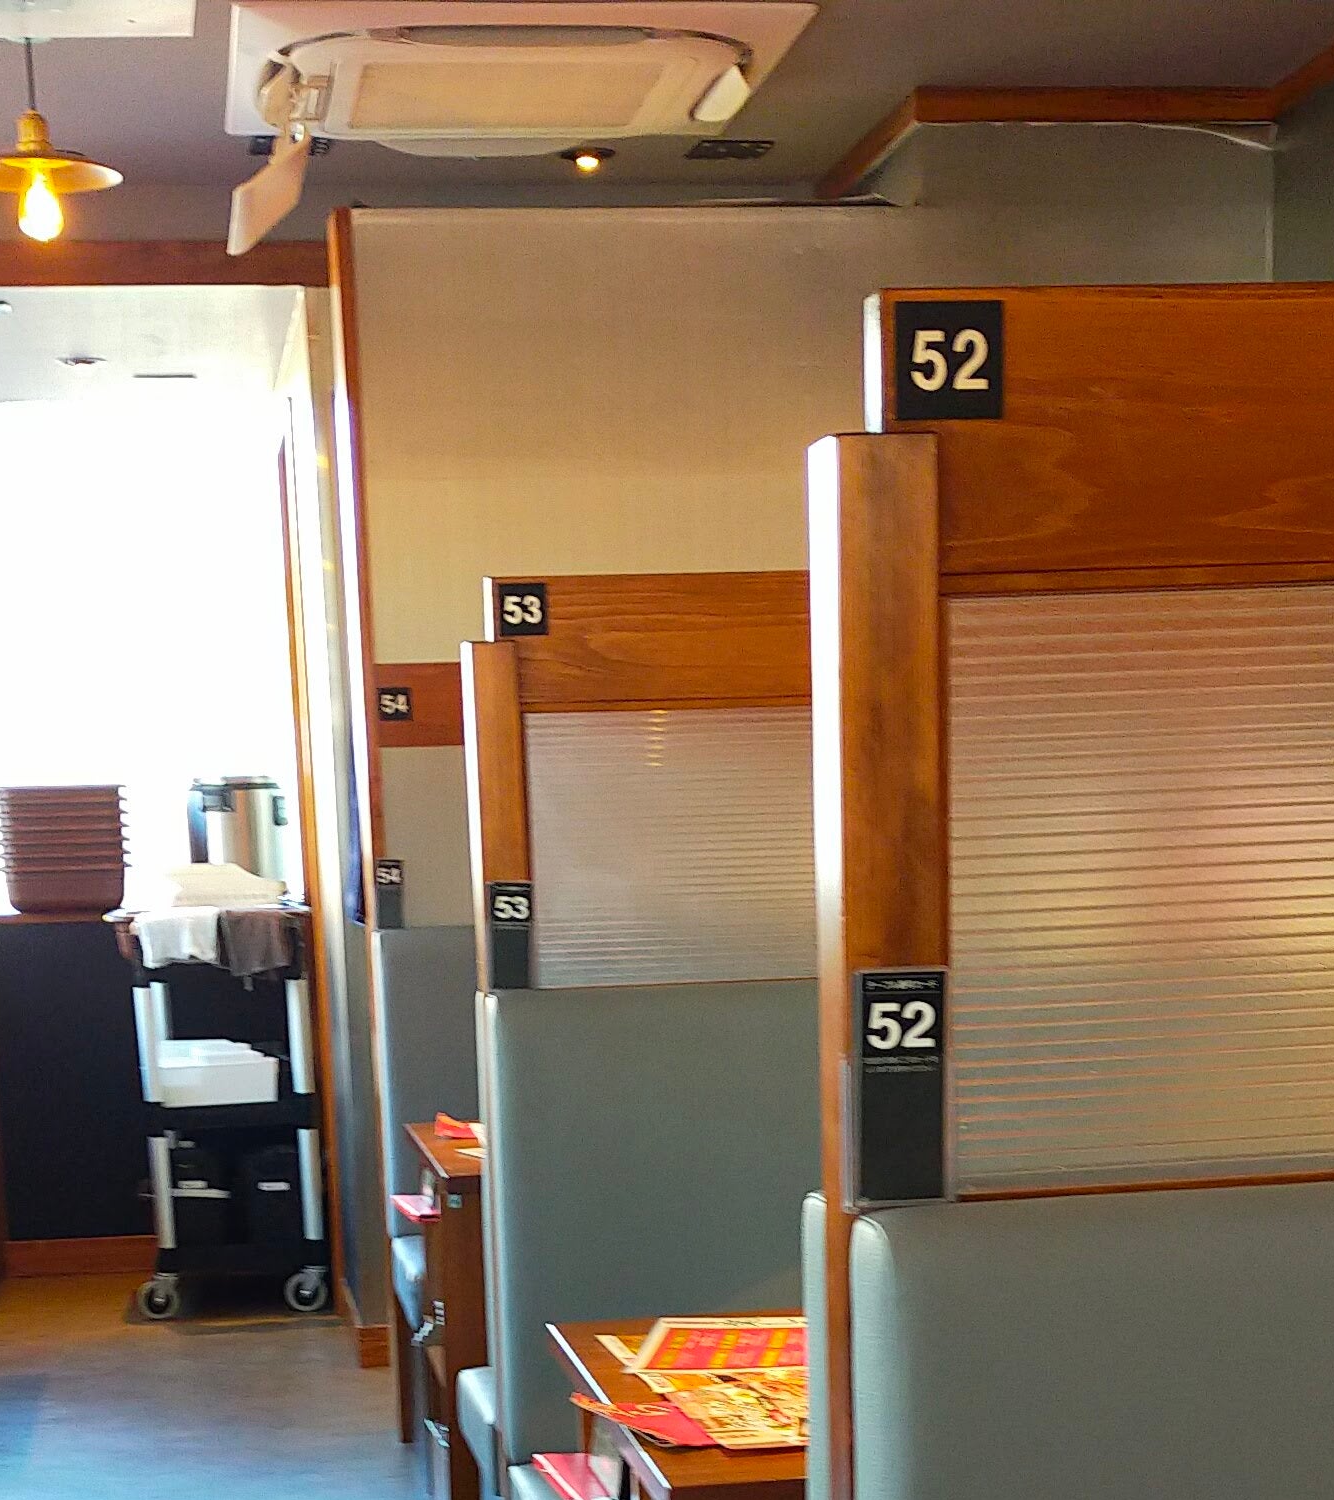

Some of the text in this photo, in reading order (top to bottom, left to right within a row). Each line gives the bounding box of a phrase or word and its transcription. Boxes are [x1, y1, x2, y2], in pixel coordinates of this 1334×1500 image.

[910, 328, 989, 391] 52
[502, 595, 543, 625] 53
[380, 694, 410, 714] 54
[376, 867, 403, 884] 54
[493, 895, 530, 924] 53
[867, 1000, 937, 1050] 52
